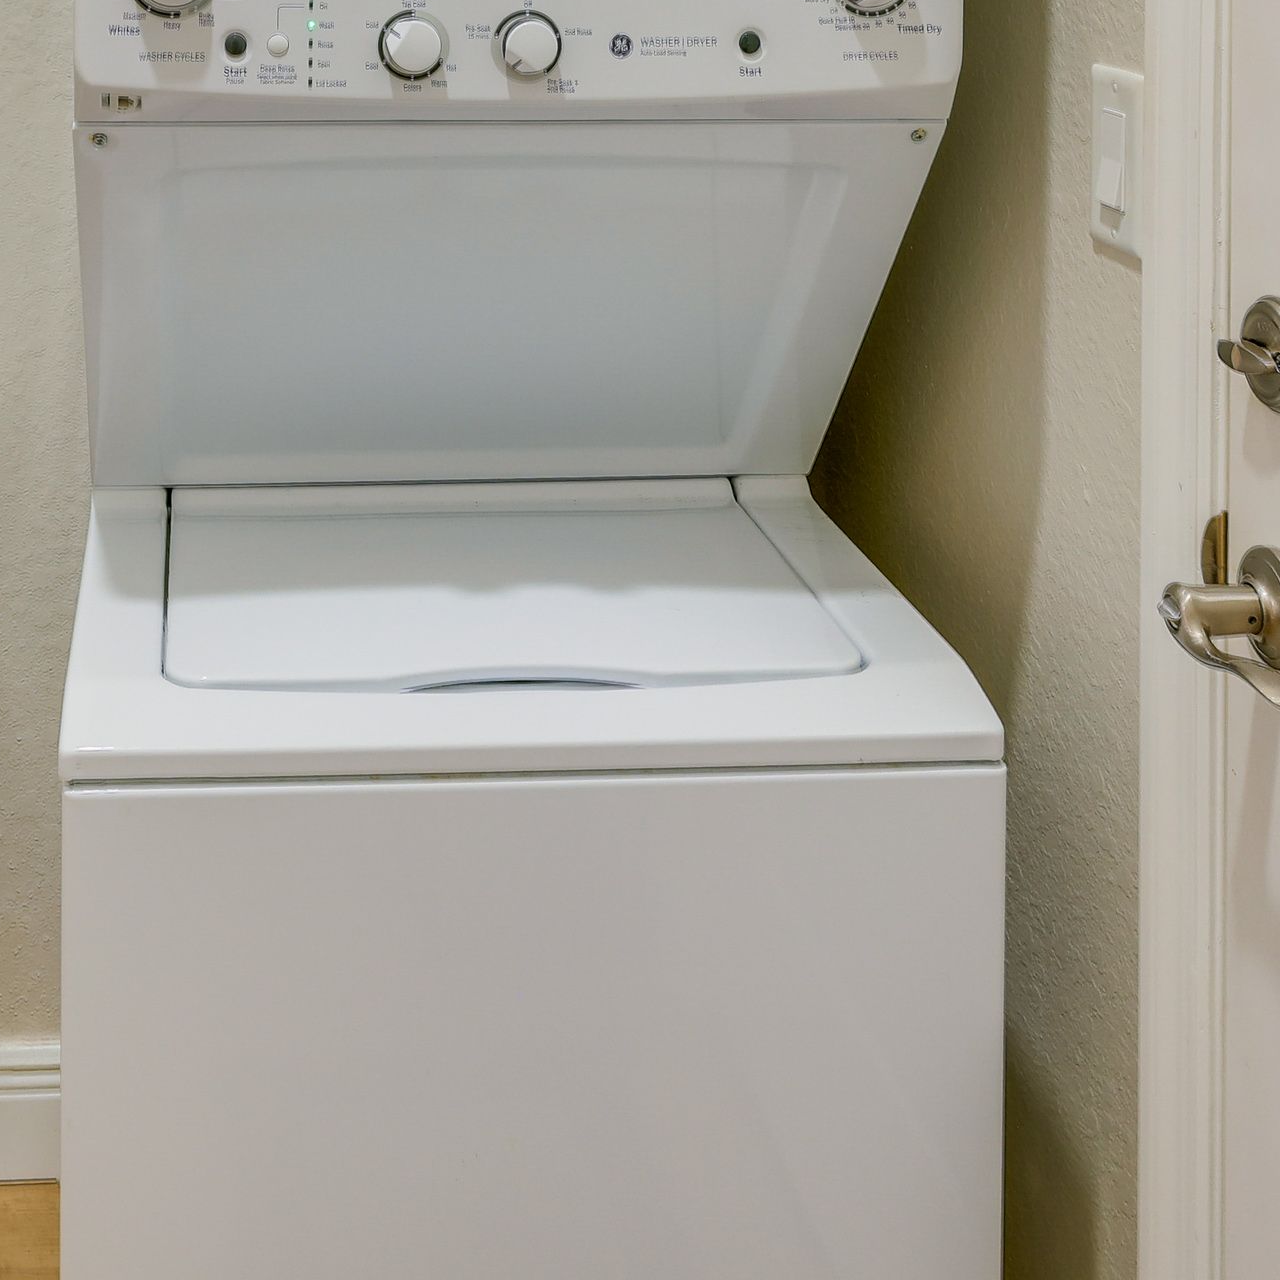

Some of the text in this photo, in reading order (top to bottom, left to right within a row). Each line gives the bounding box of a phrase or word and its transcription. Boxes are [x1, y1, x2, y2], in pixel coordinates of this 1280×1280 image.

[108, 25, 141, 36] Whites
[898, 23, 943, 36] Timed Dry
[640, 36, 718, 48] WASHER DRYER
[139, 51, 205, 63] WASHER CYCLES
[843, 51, 898, 61] DRYER CYCLES
[223, 66, 248, 78] Start
[739, 66, 762, 77] Start
